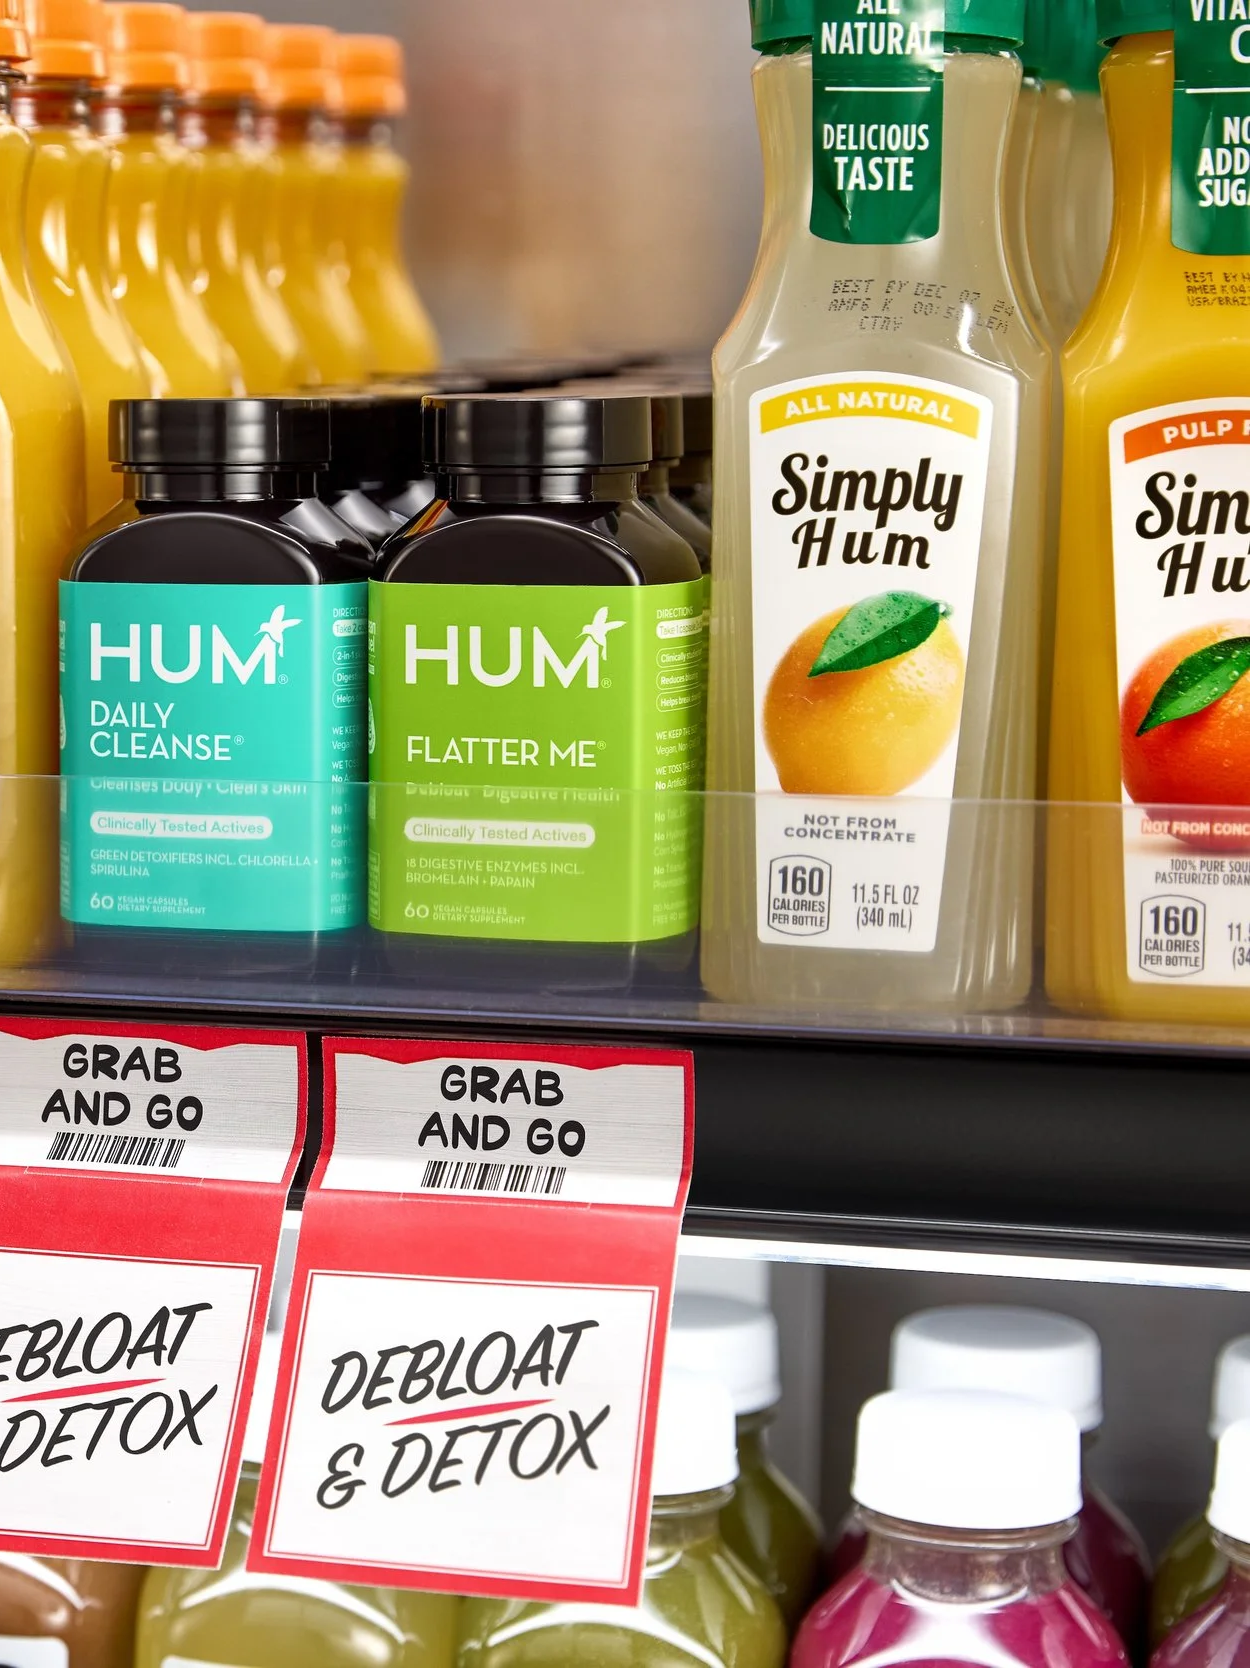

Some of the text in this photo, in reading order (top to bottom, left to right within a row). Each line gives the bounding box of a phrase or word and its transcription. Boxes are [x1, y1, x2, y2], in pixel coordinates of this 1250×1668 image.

[1190, 0, 1250, 22] VITA
[821, 22, 936, 55] NATURAL
[823, 124, 929, 151] DELICIOUS
[834, 156, 914, 191] TASTE
[1198, 178, 1250, 207] SUG
[832, 279, 875, 294] BEST
[785, 391, 954, 423] ALL NATURAL
[1163, 419, 1233, 444] PULP
[772, 453, 963, 532] Simply
[792, 517, 930, 570] Hum
[90, 623, 276, 685] HUM
[405, 624, 599, 689] HUM
[91, 700, 174, 729] DAILY
[407, 736, 539, 766] FLATTER
[97, 817, 264, 834] Clinically Tested Actives
[412, 824, 587, 842] Clinically Tested Actives
[804, 814, 896, 829] NOT FROM
[1142, 821, 1170, 834] NOT
[1172, 822, 1210, 836] FROM
[784, 827, 916, 843] CONCENTRATE
[90, 849, 128, 861] GREEN
[131, 850, 203, 865] DETOXIFIERS
[238, 854, 311, 867] CHLORELLA
[90, 864, 150, 877] SPIRULINA
[419, 859, 483, 871] DIGESTIVE
[486, 861, 547, 874] ENZYMES
[1171, 858, 1250, 874] 100% PURE SQU
[406, 872, 535, 889] BROMELAIN PAPAIN
[778, 865, 824, 897] 160
[1155, 872, 1219, 886] PASTEURIZED
[90, 892, 114, 909] 60
[773, 898, 825, 913] CALORIES
[852, 883, 920, 905] 11.5 FL OZ
[405, 902, 430, 918] 60
[772, 913, 825, 928] PER BOTTLE
[856, 906, 913, 933] (340 mL)
[1150, 906, 1198, 937] 160
[1145, 939, 1200, 953] CALORIES
[1144, 954, 1200, 968] PER BOTTLE
[63, 1044, 182, 1083] GRAB
[440, 1065, 562, 1106] GRAB
[42, 1091, 203, 1131] AND GO
[418, 1112, 586, 1157] AND GO
[321, 1320, 599, 1415] DEBLOAT
[317, 1404, 611, 1510] & DETOX
